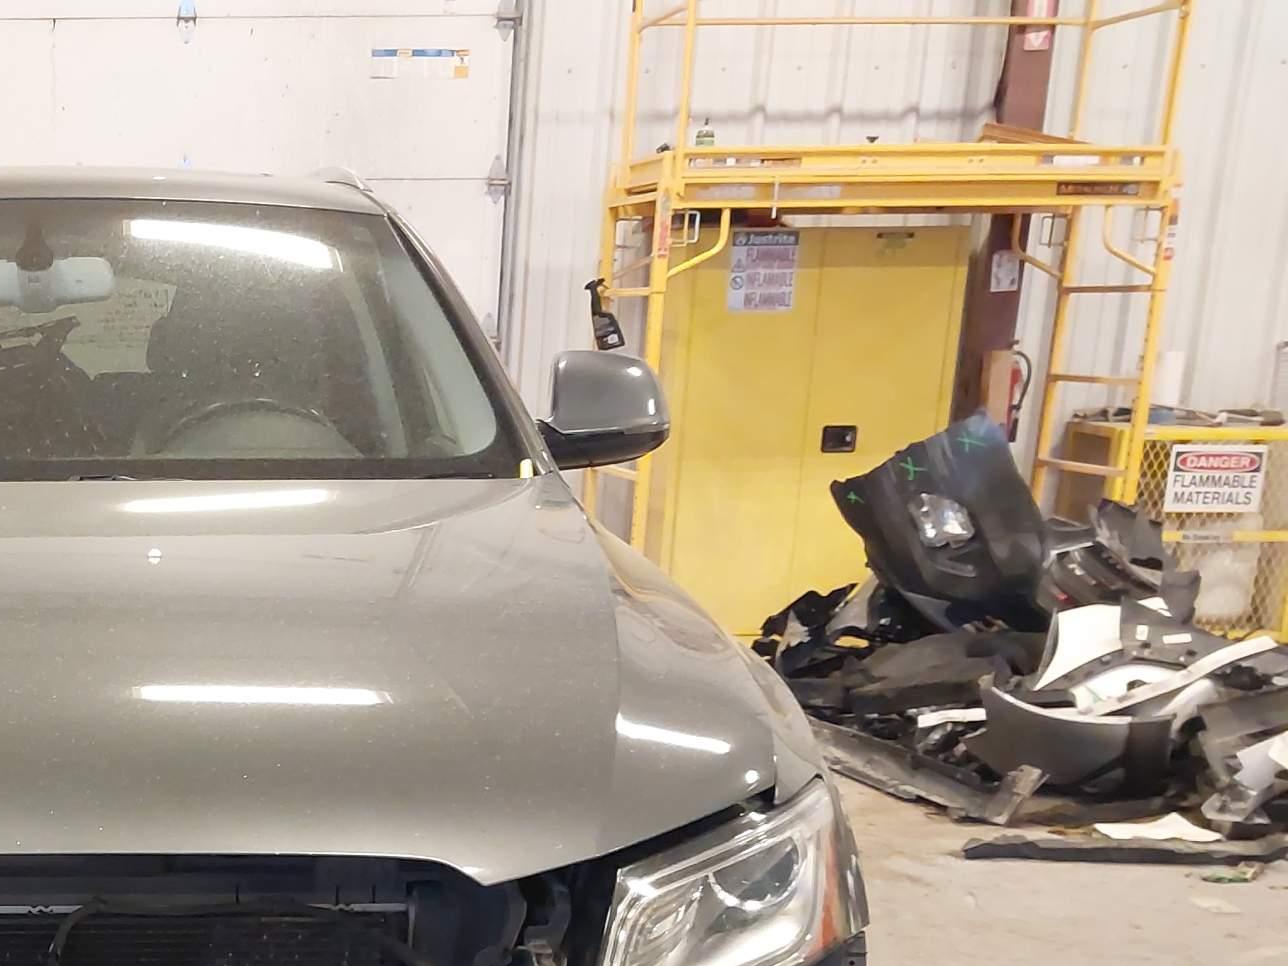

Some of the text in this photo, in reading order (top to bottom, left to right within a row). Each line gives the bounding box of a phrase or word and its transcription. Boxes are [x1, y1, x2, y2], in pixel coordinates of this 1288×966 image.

[748, 234, 796, 245] Justrite
[1186, 456, 1250, 468] DANGER
[1173, 475, 1257, 488] FLAMMABLE
[1172, 491, 1252, 504] MATERIALS
